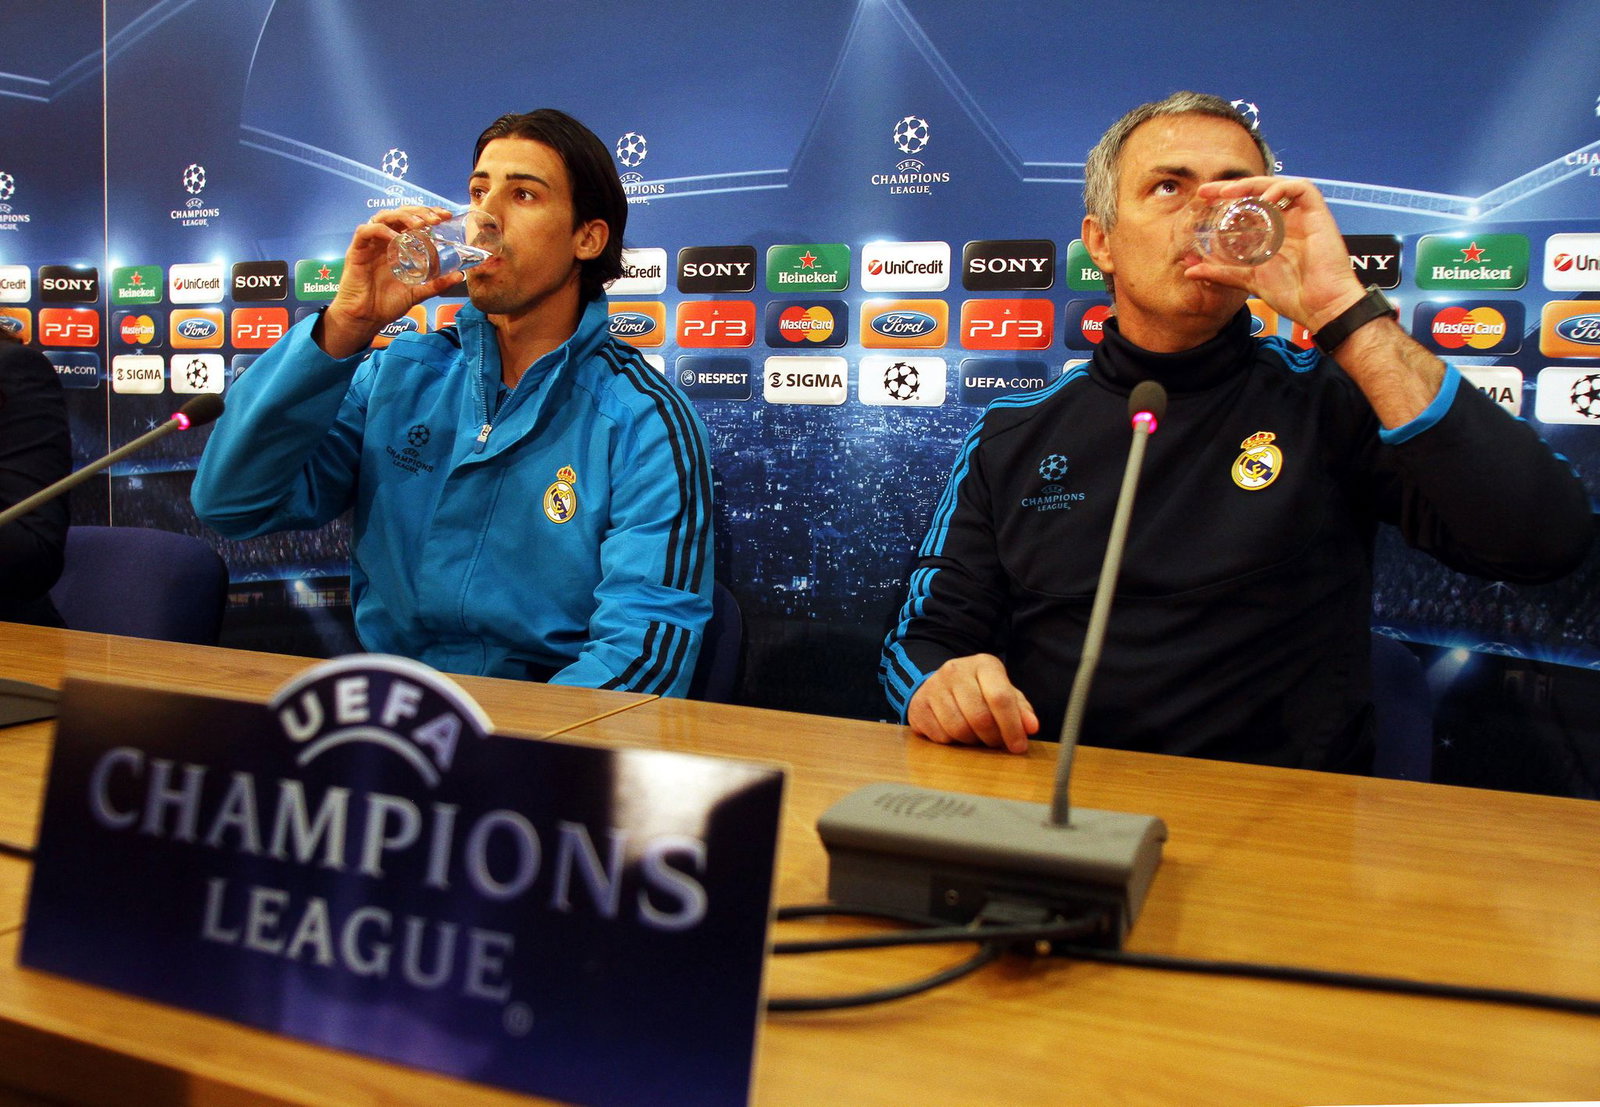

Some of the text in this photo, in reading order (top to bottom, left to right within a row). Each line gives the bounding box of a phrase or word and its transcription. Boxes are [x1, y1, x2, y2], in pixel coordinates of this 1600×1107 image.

[897, 161, 923, 170] UEFA
[620, 174, 642, 183] UEFA
[871, 172, 950, 186] CHAMPIONS
[624, 184, 665, 195] MPIONS
[890, 186, 930, 195] LEAGUE
[367, 196, 424, 208] CHAMPIONS
[171, 208, 220, 220] CHAMPIONS
[183, 219, 207, 227] LEAGUE
[884, 260, 943, 276] UniCredit
[969, 258, 1048, 273] SONY
[1349, 255, 1395, 270] NY
[683, 263, 750, 277] SONY
[778, 270, 838, 284] Heineken
[1431, 266, 1513, 281] Heineken
[43, 278, 94, 291] SONY
[184, 278, 220, 290] UniCredit
[235, 275, 283, 288] SONY
[303, 282, 340, 293] Heineke
[118, 287, 156, 298] Heineken
[46, 323, 93, 338] PS3
[121, 325, 155, 335] MasterCard
[184, 321, 210, 336] Ford
[237, 324, 283, 339] PS3
[609, 315, 645, 334] Ford
[684, 320, 747, 337] PS3
[780, 319, 833, 331] MasterCard
[882, 315, 923, 334] Ford
[969, 320, 1043, 338] PS3
[1432, 321, 1504, 335] MasterCard
[1570, 319, 1600, 340] Fo
[127, 368, 161, 380] SIGMA
[698, 372, 747, 385] RESPECT
[786, 374, 843, 388] SIGMA
[386, 445, 434, 473] CHAMPIONS
[393, 460, 419, 475] LEAGUE
[1021, 492, 1085, 507] CHAMPIONS
[1038, 502, 1068, 512] LEAGUE
[278, 675, 463, 771] UEFA
[89, 745, 709, 932] CHAMPIONS
[201, 876, 515, 1002] LEAGUE
